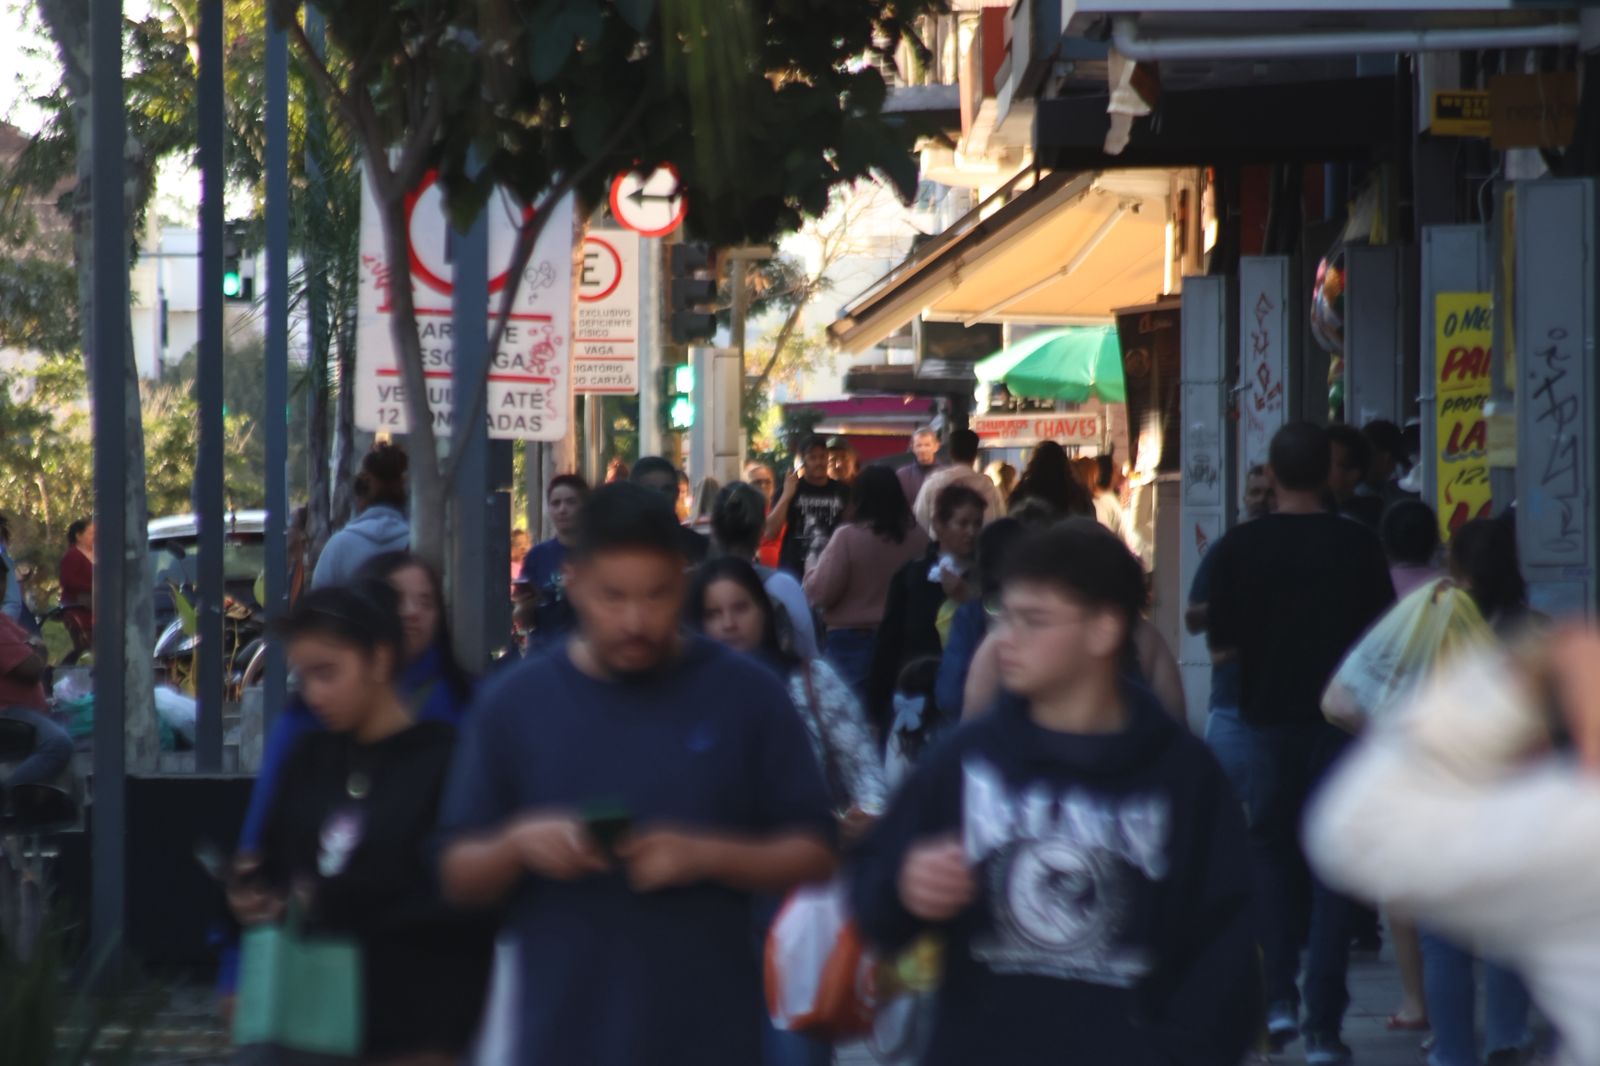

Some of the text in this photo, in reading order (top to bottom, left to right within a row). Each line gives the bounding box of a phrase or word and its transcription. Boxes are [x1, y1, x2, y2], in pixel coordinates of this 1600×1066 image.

[579, 309, 631, 318] EXCLUSIVO
[579, 319, 632, 328] DEFICIENTE
[584, 346, 615, 355] VAGA
[590, 374, 632, 385] CARTÃO
[501, 387, 543, 409] ATÉ
[377, 408, 399, 425] 12
[1034, 418, 1097, 438] CHAVES
